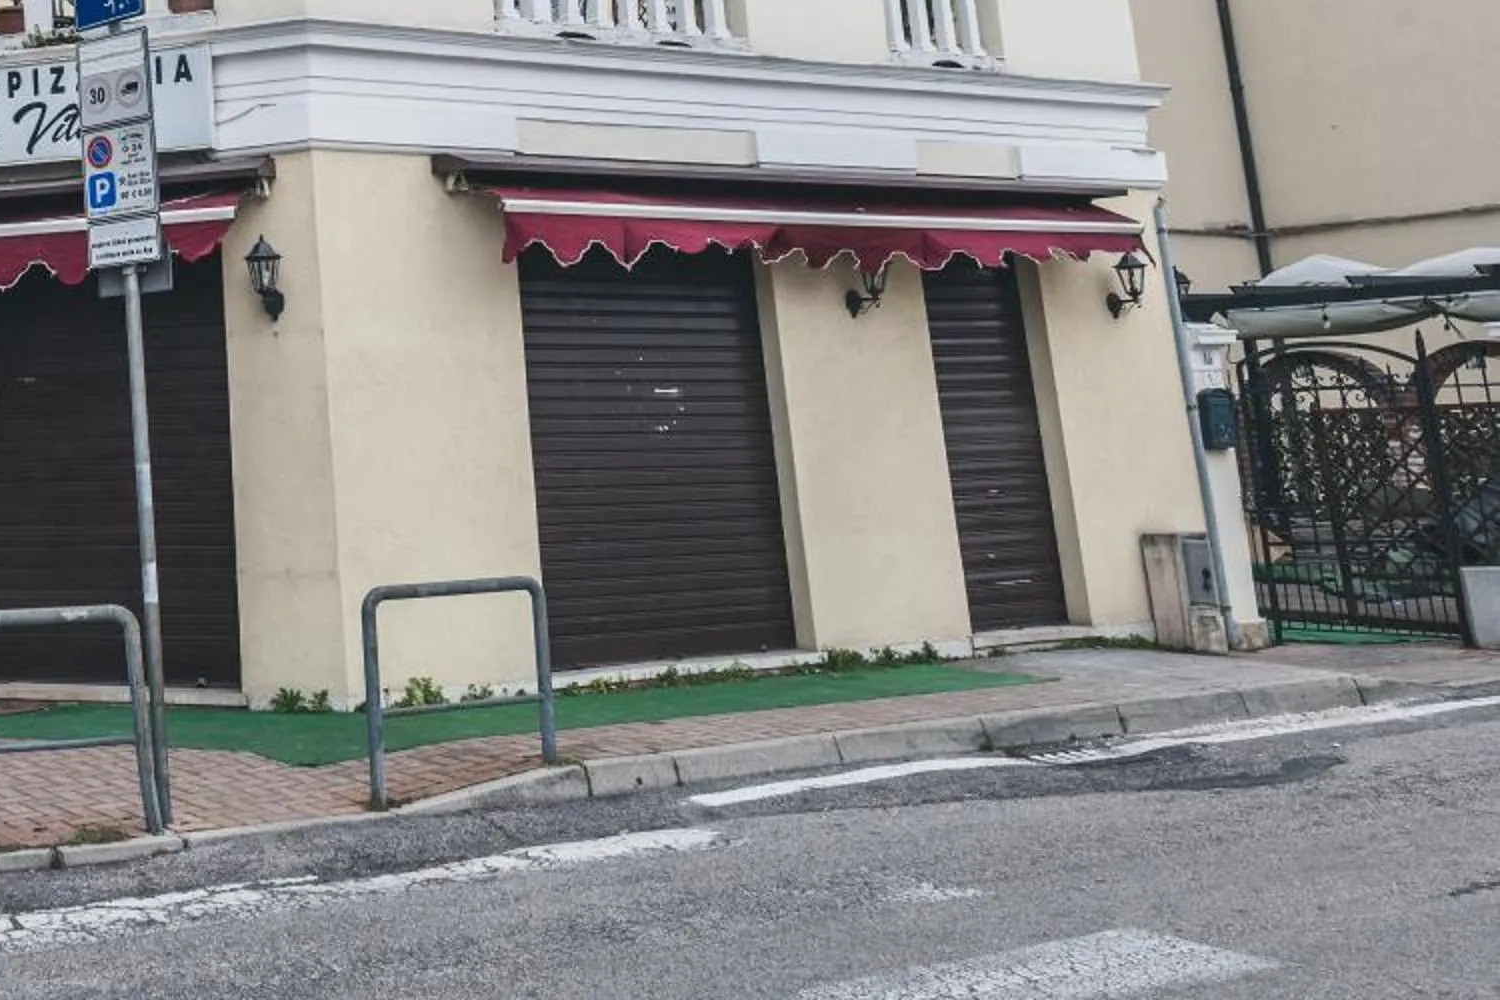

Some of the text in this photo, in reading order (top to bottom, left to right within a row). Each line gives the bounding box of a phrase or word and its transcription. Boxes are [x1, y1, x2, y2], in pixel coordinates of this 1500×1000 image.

[7, 54, 193, 99] PIZIA
[89, 87, 105, 105] 30
[12, 101, 81, 156] Vit
[95, 178, 111, 204] P
